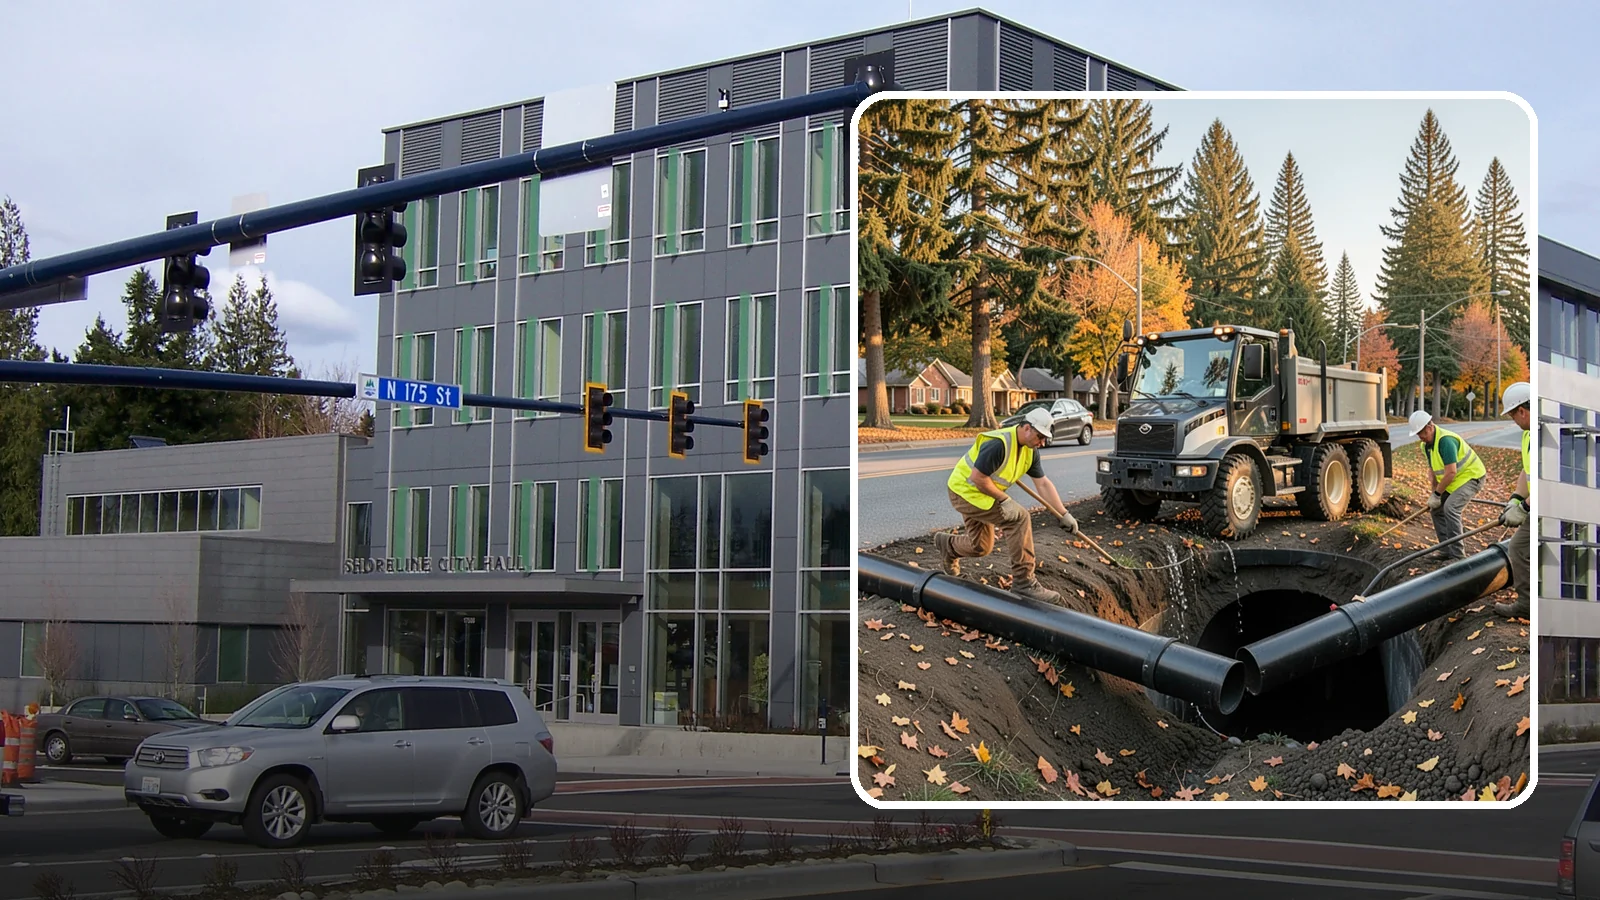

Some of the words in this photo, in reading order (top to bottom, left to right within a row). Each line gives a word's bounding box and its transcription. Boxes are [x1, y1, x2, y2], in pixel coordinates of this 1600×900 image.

[387, 381, 396, 400] N
[405, 383, 427, 403] 175
[436, 386, 451, 406] St
[344, 556, 432, 574] SHORELINE
[438, 556, 476, 572] CITY
[483, 555, 525, 571] HALL
